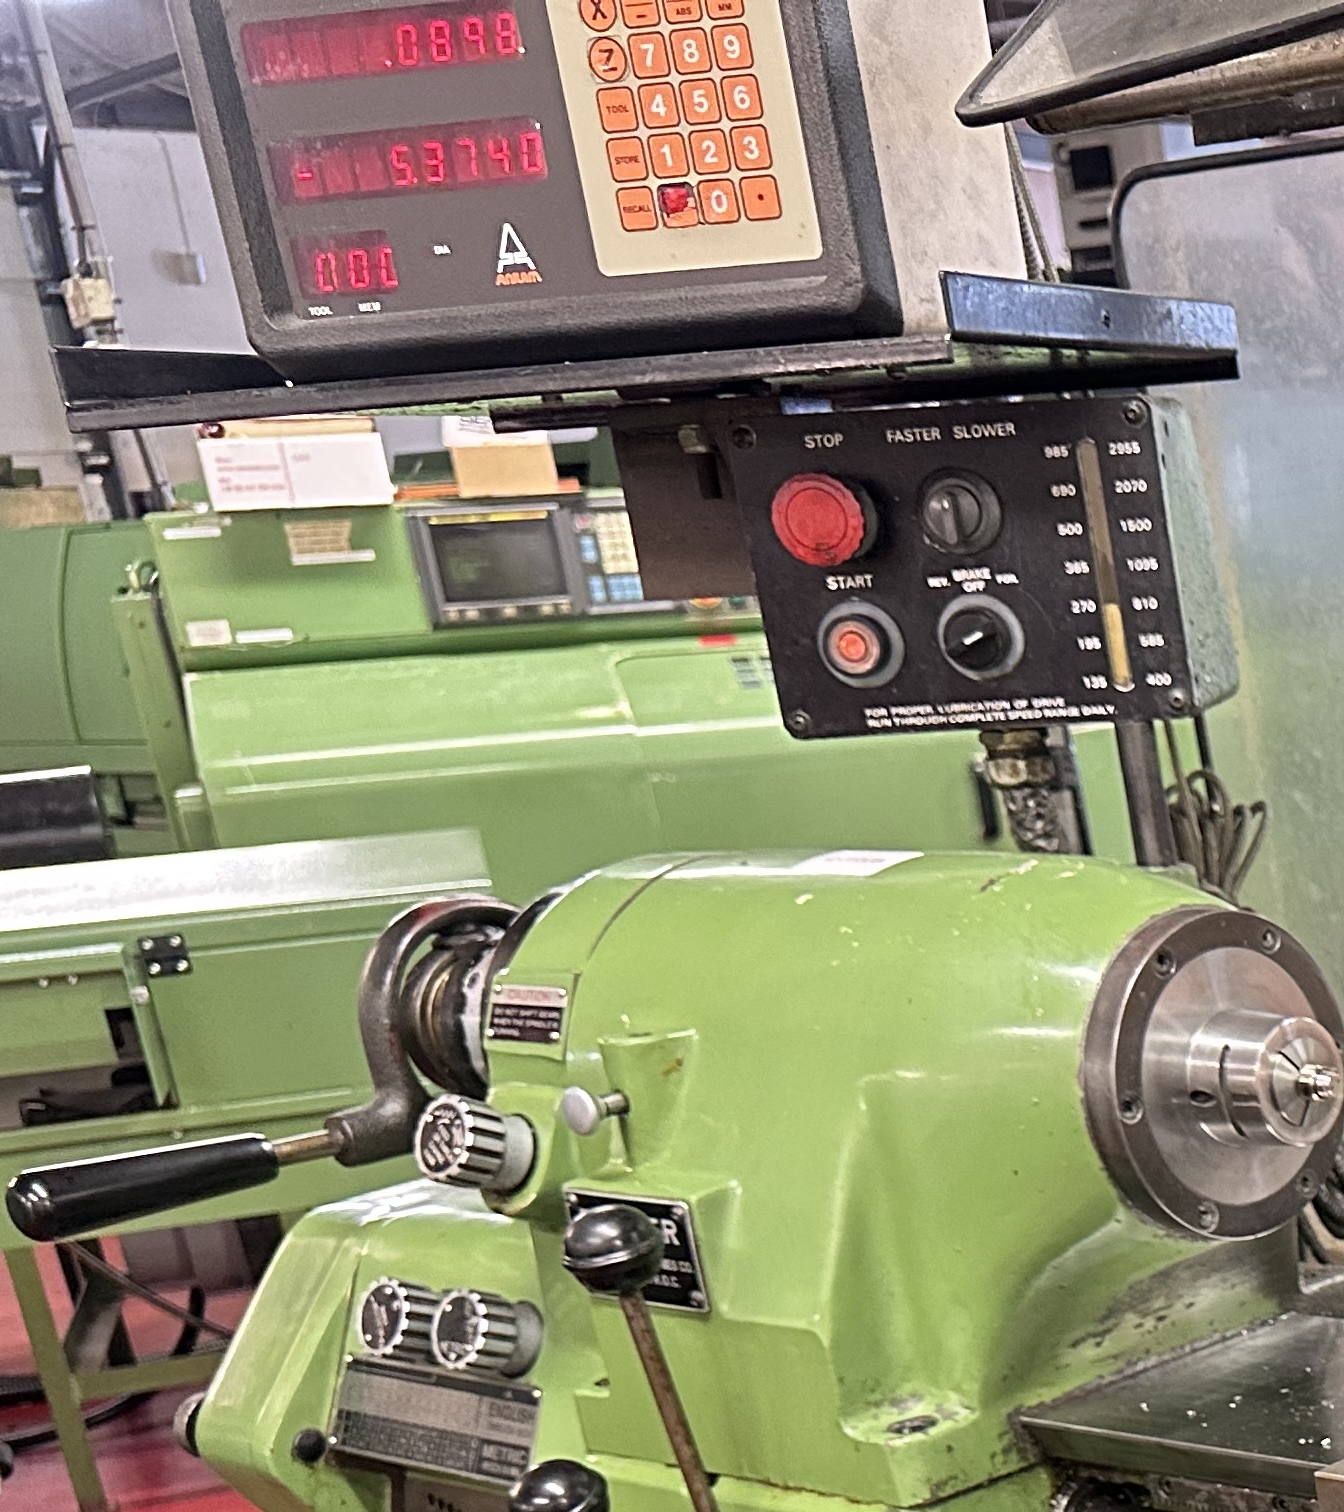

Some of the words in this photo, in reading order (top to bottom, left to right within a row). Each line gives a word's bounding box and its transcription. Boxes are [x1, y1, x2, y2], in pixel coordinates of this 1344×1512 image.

[640, 43, 655, 67] 7
[682, 39, 700, 63] 8
[723, 34, 741, 59] 9
[650, 93, 668, 117] 4
[692, 89, 709, 113] 5
[733, 85, 751, 109] 6
[606, 104, 630, 114] TOOL
[659, 144, 673, 167] 1
[701, 140, 719, 163] 2
[742, 136, 760, 159] 3
[711, 189, 728, 214] 0
[308, 306, 334, 317] TOOL
[803, 432, 845, 449] STOP
[886, 426, 943, 443] FASTER
[952, 422, 1017, 440] SLOWER
[1113, 478, 1149, 494] 2070
[824, 573, 874, 591] START
[1070, 598, 1097, 614] 270
